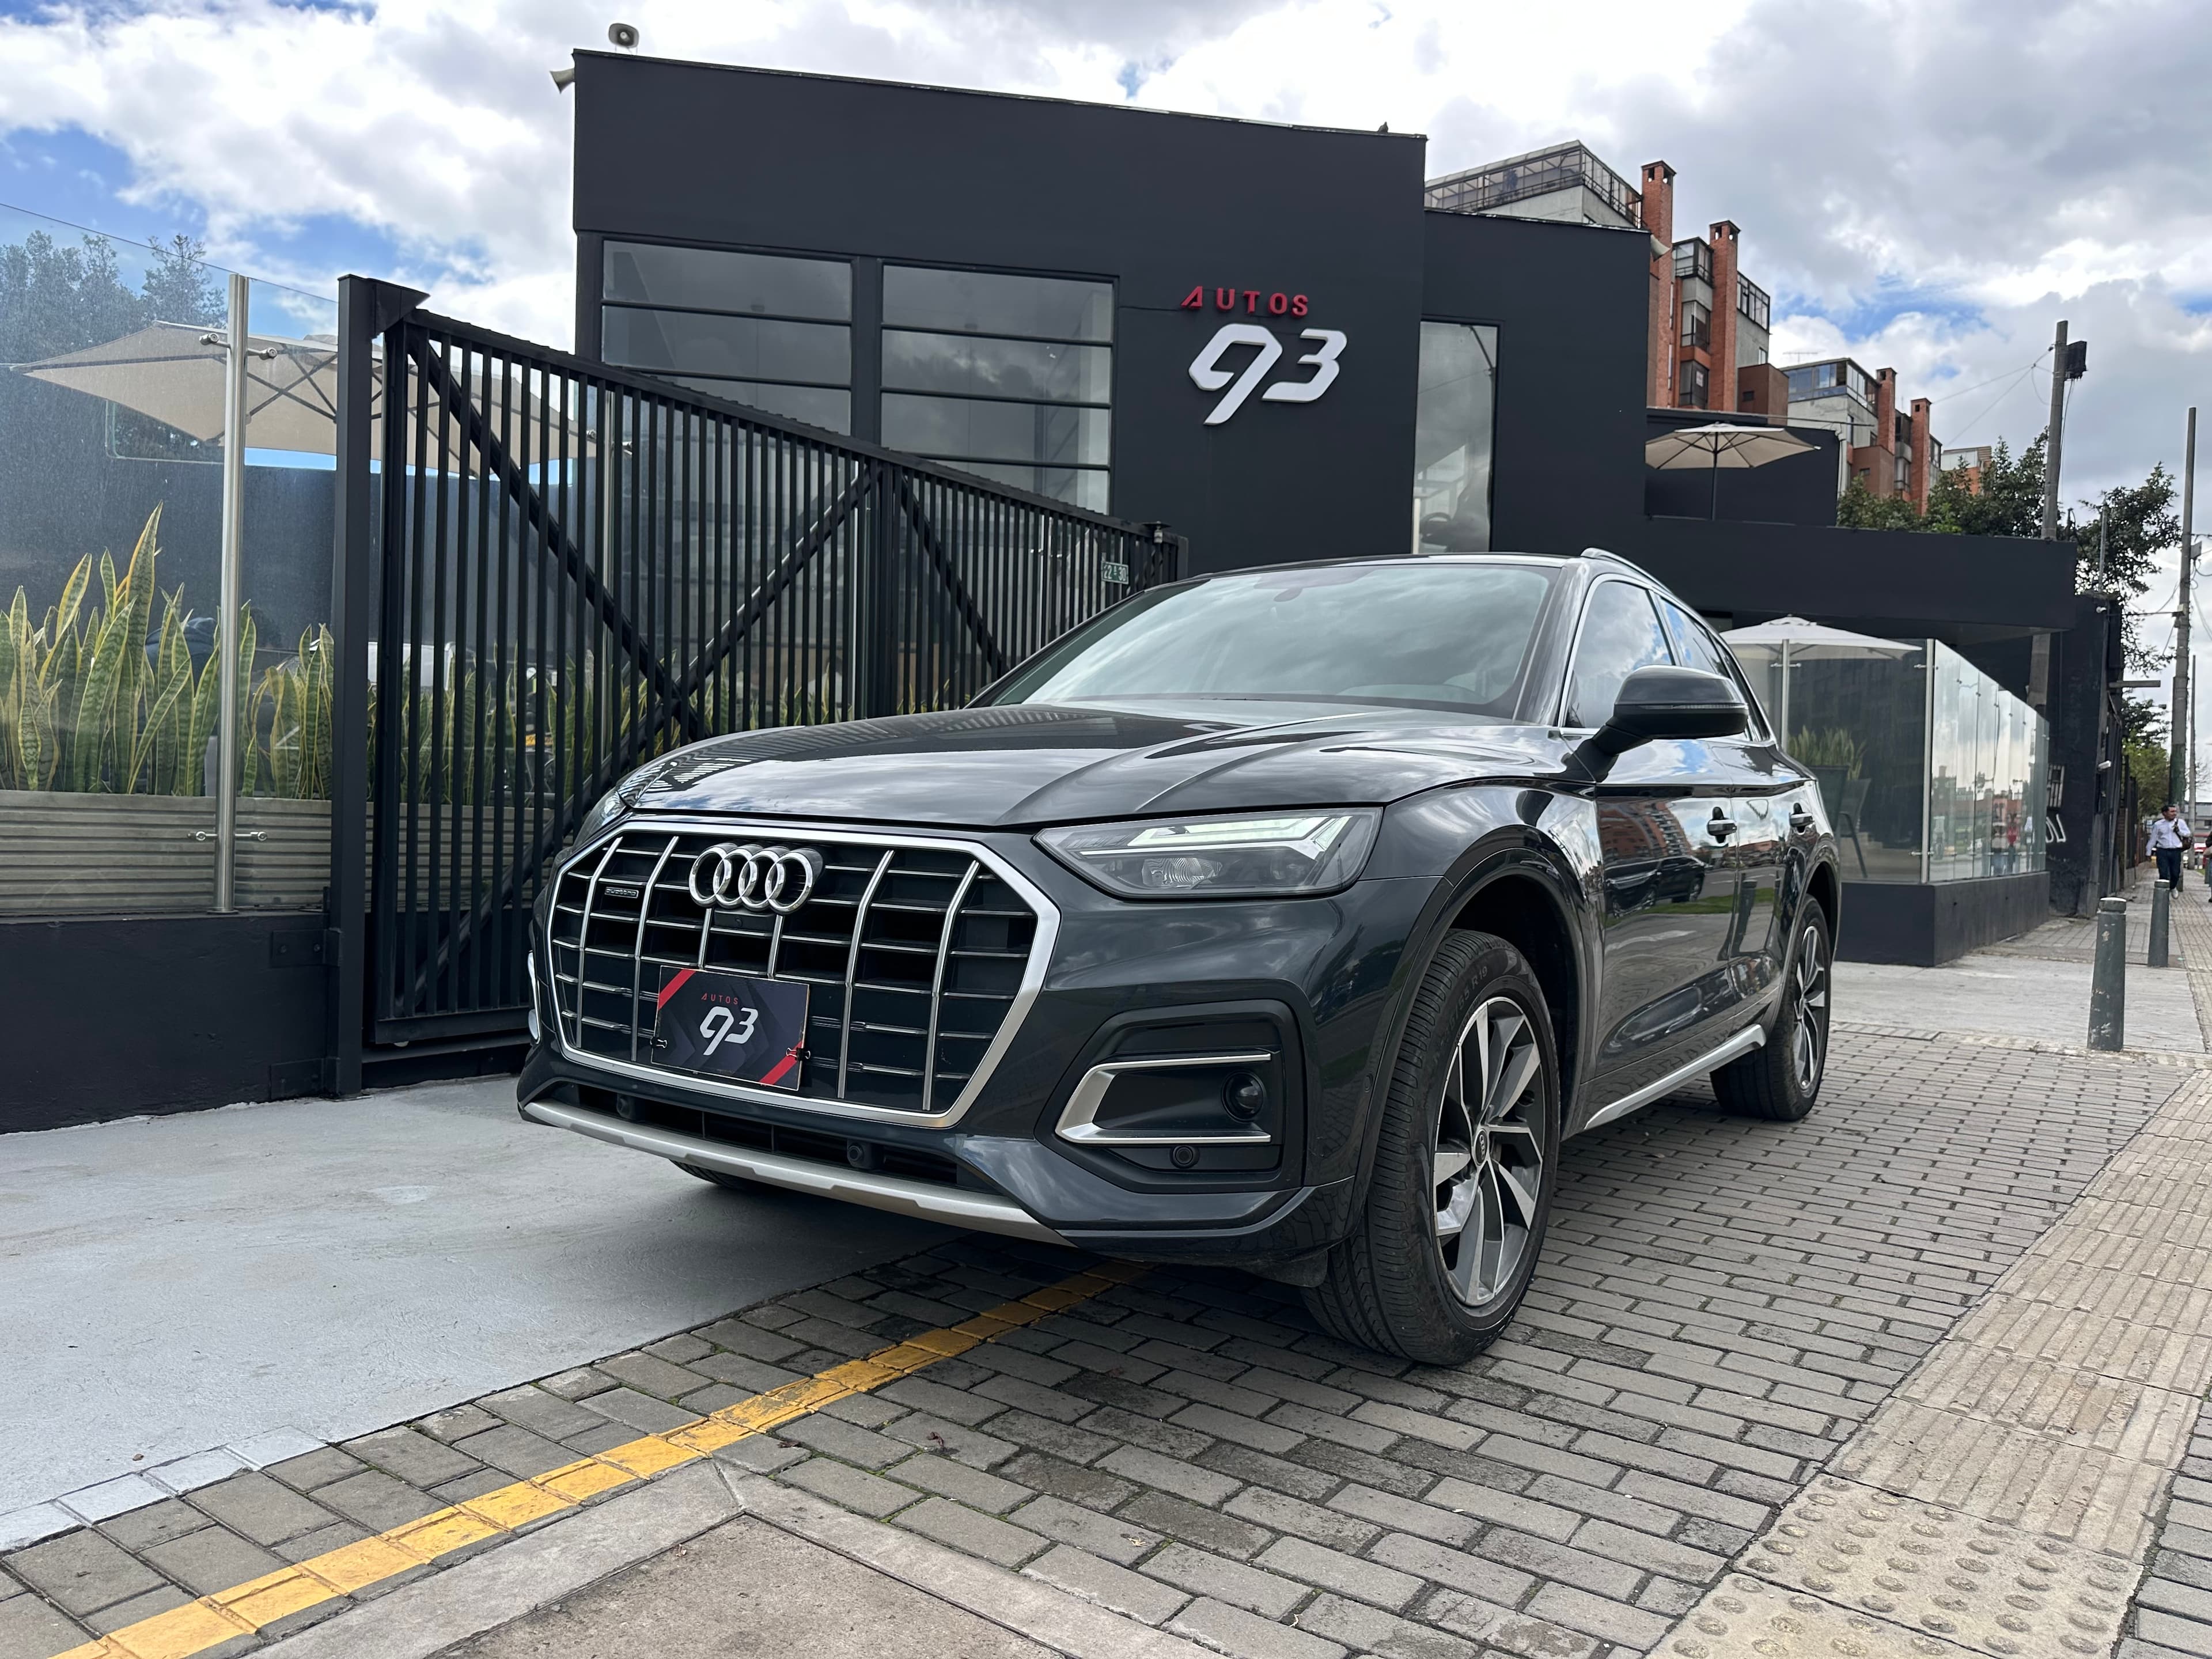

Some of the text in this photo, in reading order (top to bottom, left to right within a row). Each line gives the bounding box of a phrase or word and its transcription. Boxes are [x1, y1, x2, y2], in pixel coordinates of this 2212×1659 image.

[1180, 286, 1309, 317] AUTOS
[1188, 323, 1348, 426] 93
[701, 993, 738, 1005] AUTOS
[699, 1006, 759, 1056] 93
